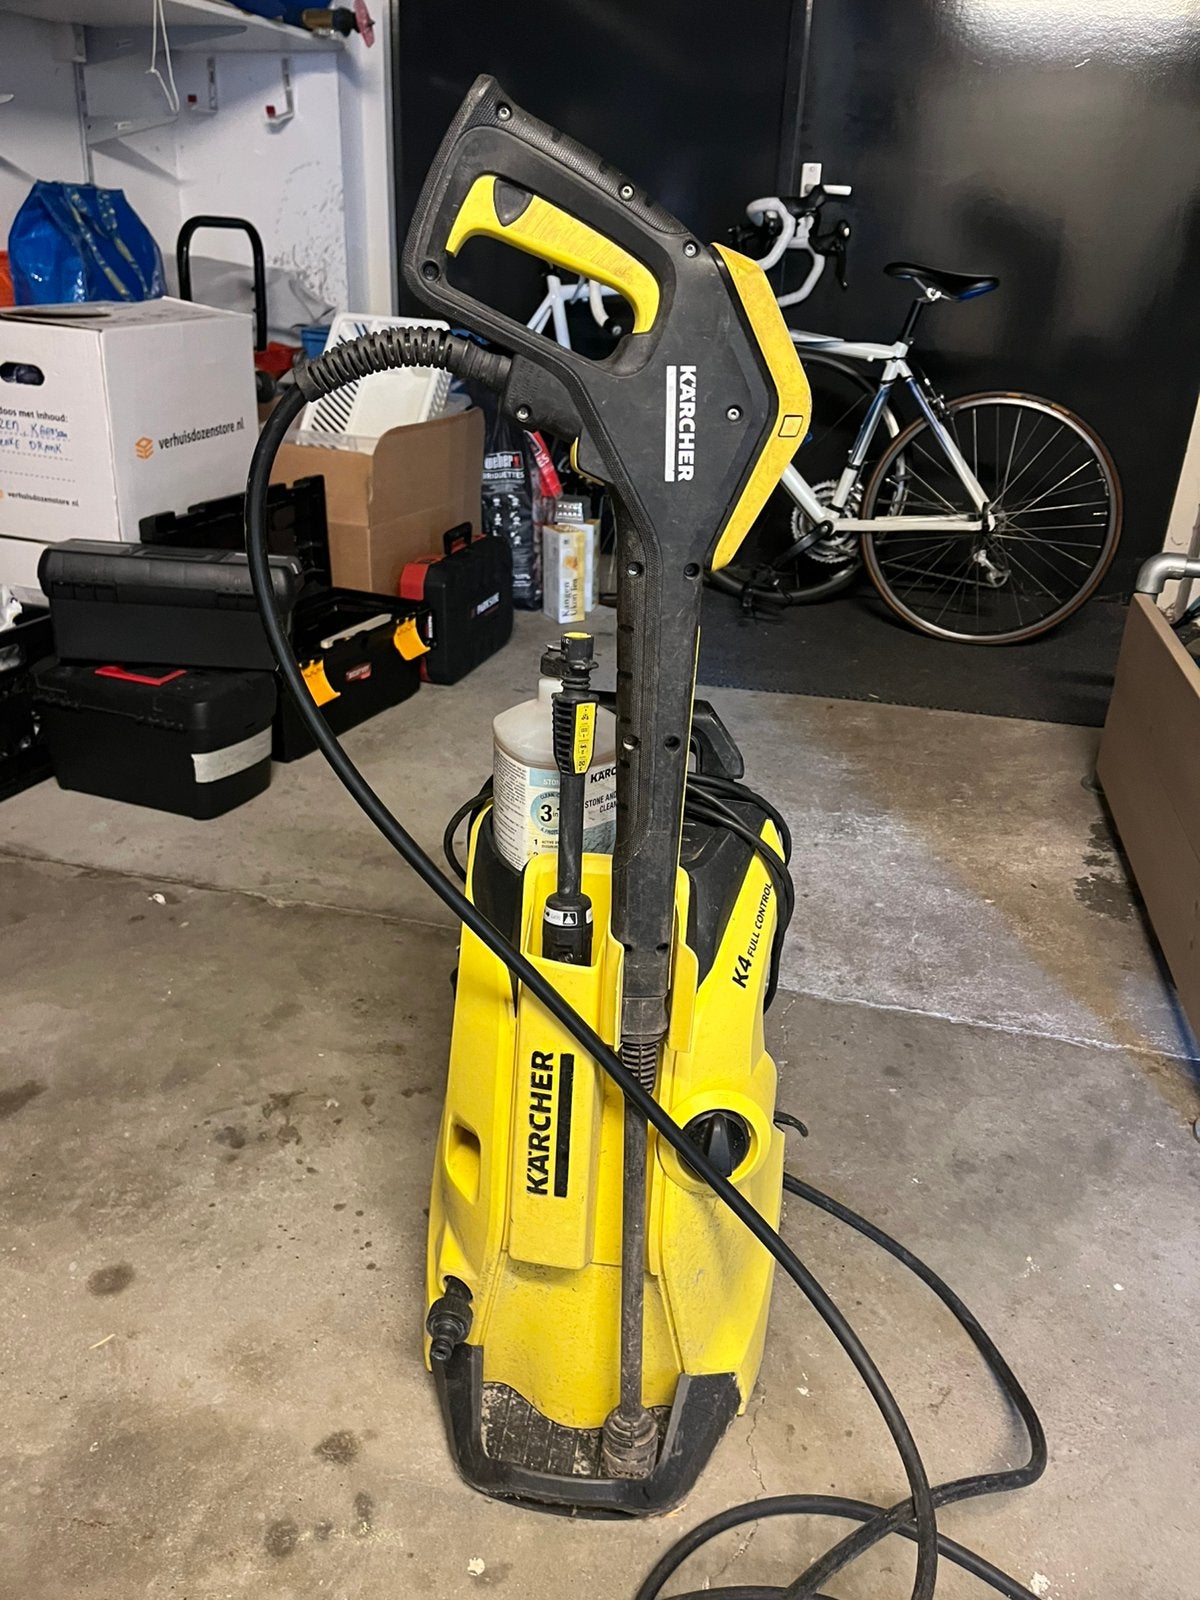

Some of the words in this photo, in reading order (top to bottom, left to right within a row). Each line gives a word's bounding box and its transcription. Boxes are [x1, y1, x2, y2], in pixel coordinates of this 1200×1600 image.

[677, 365, 697, 482] KÄRCHER
[543, 778, 560, 786] STON
[585, 795, 605, 809] STONE
[590, 766, 617, 784] KÄRC
[732, 954, 752, 989] K4
[747, 932, 760, 958] FULL
[755, 883, 773, 930] CONTROL
[526, 1050, 554, 1195] KÄRCHER
